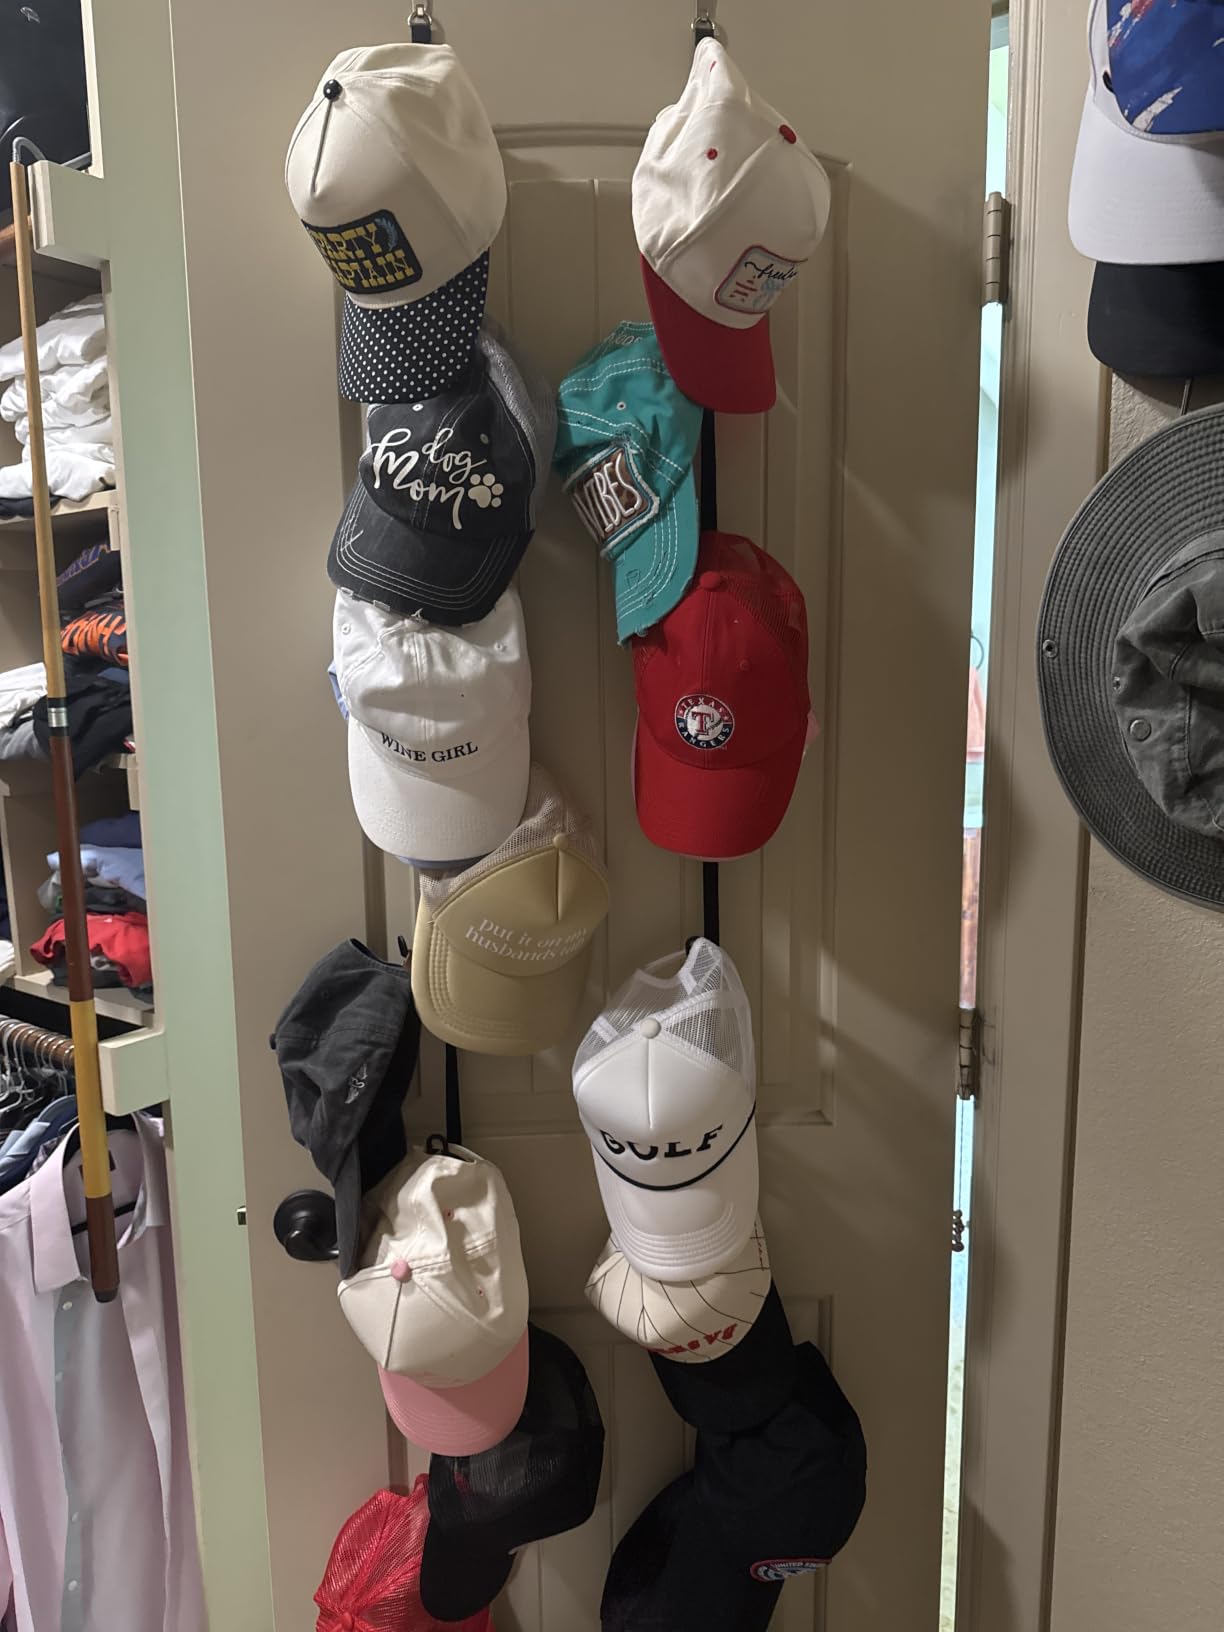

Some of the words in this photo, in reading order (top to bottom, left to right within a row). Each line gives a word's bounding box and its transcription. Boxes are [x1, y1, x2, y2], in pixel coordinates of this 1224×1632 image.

[421, 427, 488, 485] dog
[358, 428, 465, 531] Mom
[572, 451, 642, 542] VIBES
[681, 697, 726, 714] TEXAS
[677, 722, 730, 748] RANGERS
[690, 711, 715, 736] T
[381, 731, 427, 762] WINE
[431, 741, 479, 763] GIRL
[465, 925, 556, 961] husbands
[479, 919, 513, 941] Put
[518, 930, 534, 945] it
[599, 1124, 724, 1161] GOLF
